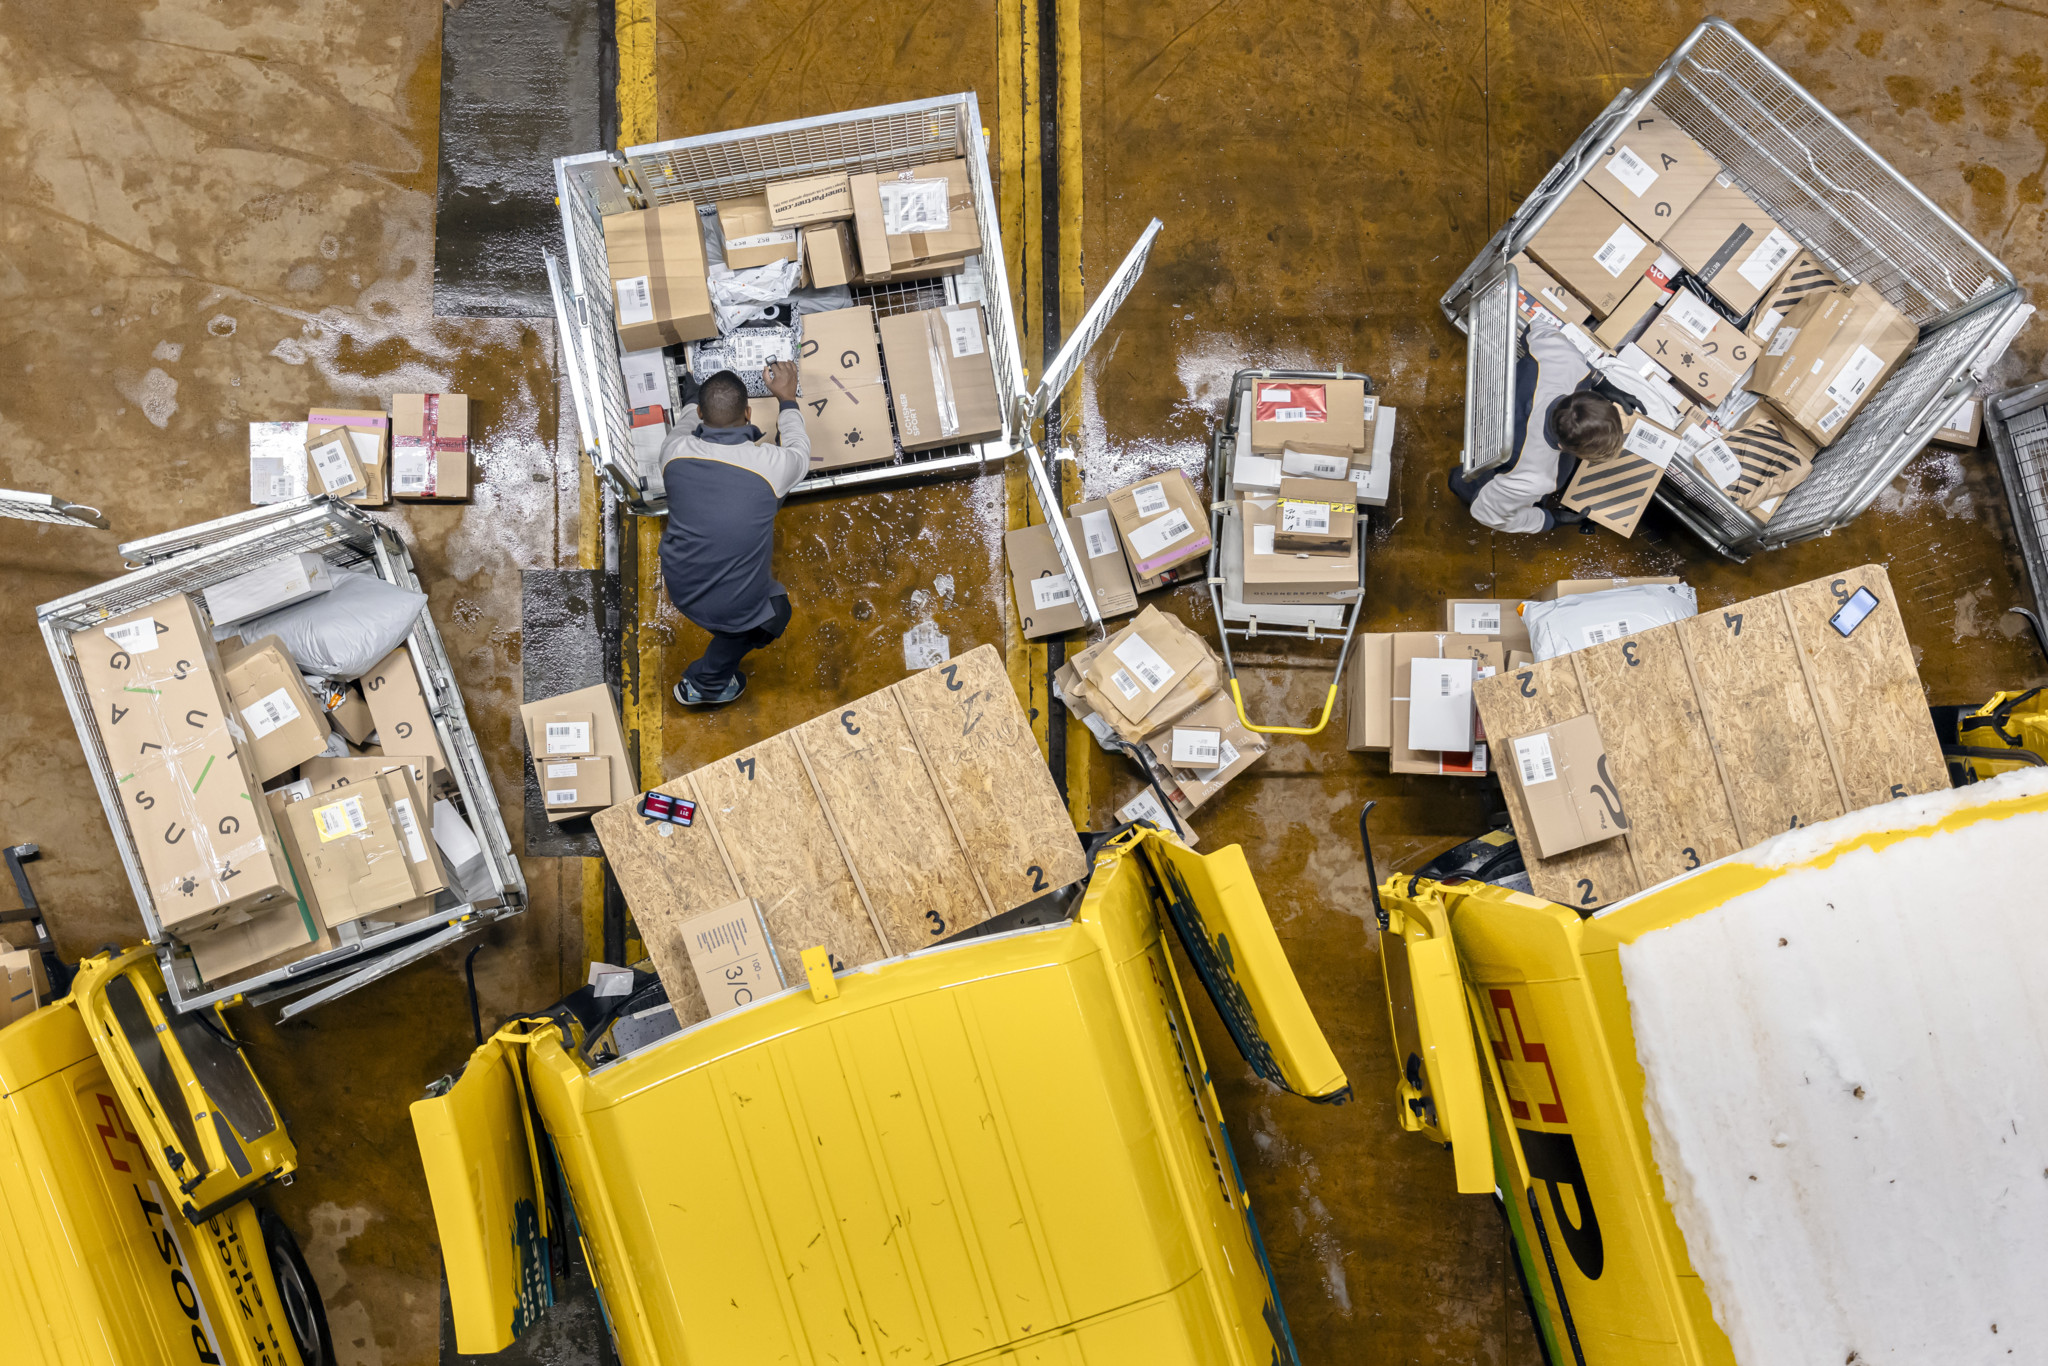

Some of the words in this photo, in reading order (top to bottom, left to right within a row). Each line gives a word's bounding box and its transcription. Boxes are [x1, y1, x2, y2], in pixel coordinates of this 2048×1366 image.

[1638, 119, 1654, 130] L
[1660, 153, 1678, 171] A
[775, 186, 848, 214] TonerPartner.com
[1655, 202, 1672, 217] G
[1706, 261, 1721, 278] BETTY
[1656, 338, 1669, 355] X
[1702, 341, 1719, 357] U
[1732, 345, 1747, 361] G
[840, 350, 860, 369] G
[1698, 372, 1709, 388] S
[808, 398, 829, 417] A
[908, 408, 921, 437] SPORT
[1723, 612, 1744, 637] 4
[109, 651, 131, 671] G
[1622, 641, 1641, 667] 3
[174, 659, 191, 680] S
[940, 664, 964, 692] 2
[368, 675, 386, 692] S
[1516, 671, 1538, 698] 2
[111, 703, 130, 725] A
[185, 709, 208, 729] U
[840, 709, 861, 736] 3
[394, 721, 413, 739] G
[140, 741, 163, 755] L
[735, 757, 757, 781] 4
[135, 790, 155, 810] S
[164, 821, 186, 845] U
[218, 815, 240, 835] G
[1682, 847, 1701, 872] 3
[220, 860, 242, 882] A
[1025, 865, 1050, 893] 2
[1576, 878, 1599, 906] 2
[925, 909, 946, 936] 3
[1518, 1129, 1605, 1281] P
